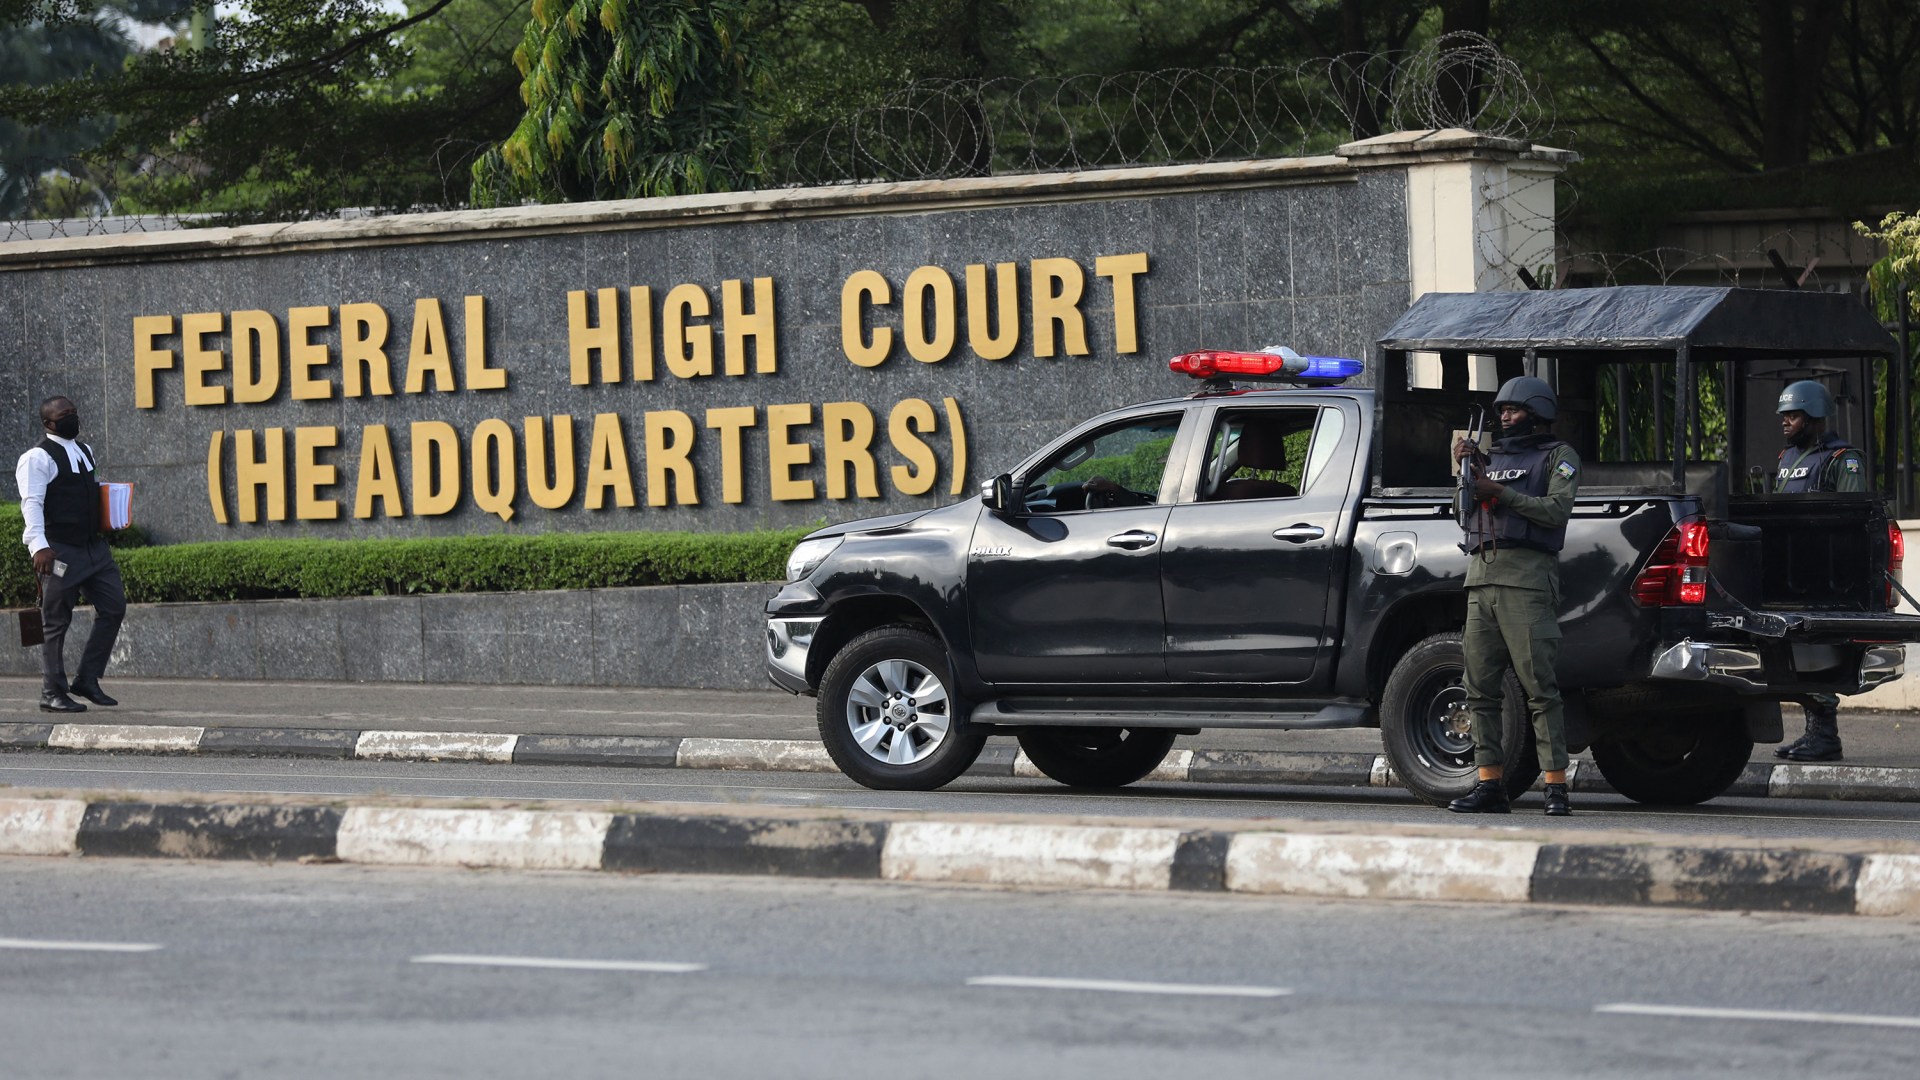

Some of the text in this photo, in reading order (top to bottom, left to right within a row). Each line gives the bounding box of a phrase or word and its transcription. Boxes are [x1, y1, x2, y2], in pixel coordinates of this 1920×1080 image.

[133, 252, 1149, 410] FEDERAL HIGH COURT
[207, 397, 967, 525] (HEADQUARTERS)
[1485, 468, 1527, 481] OLICE
[1777, 467, 1809, 479] POICE
